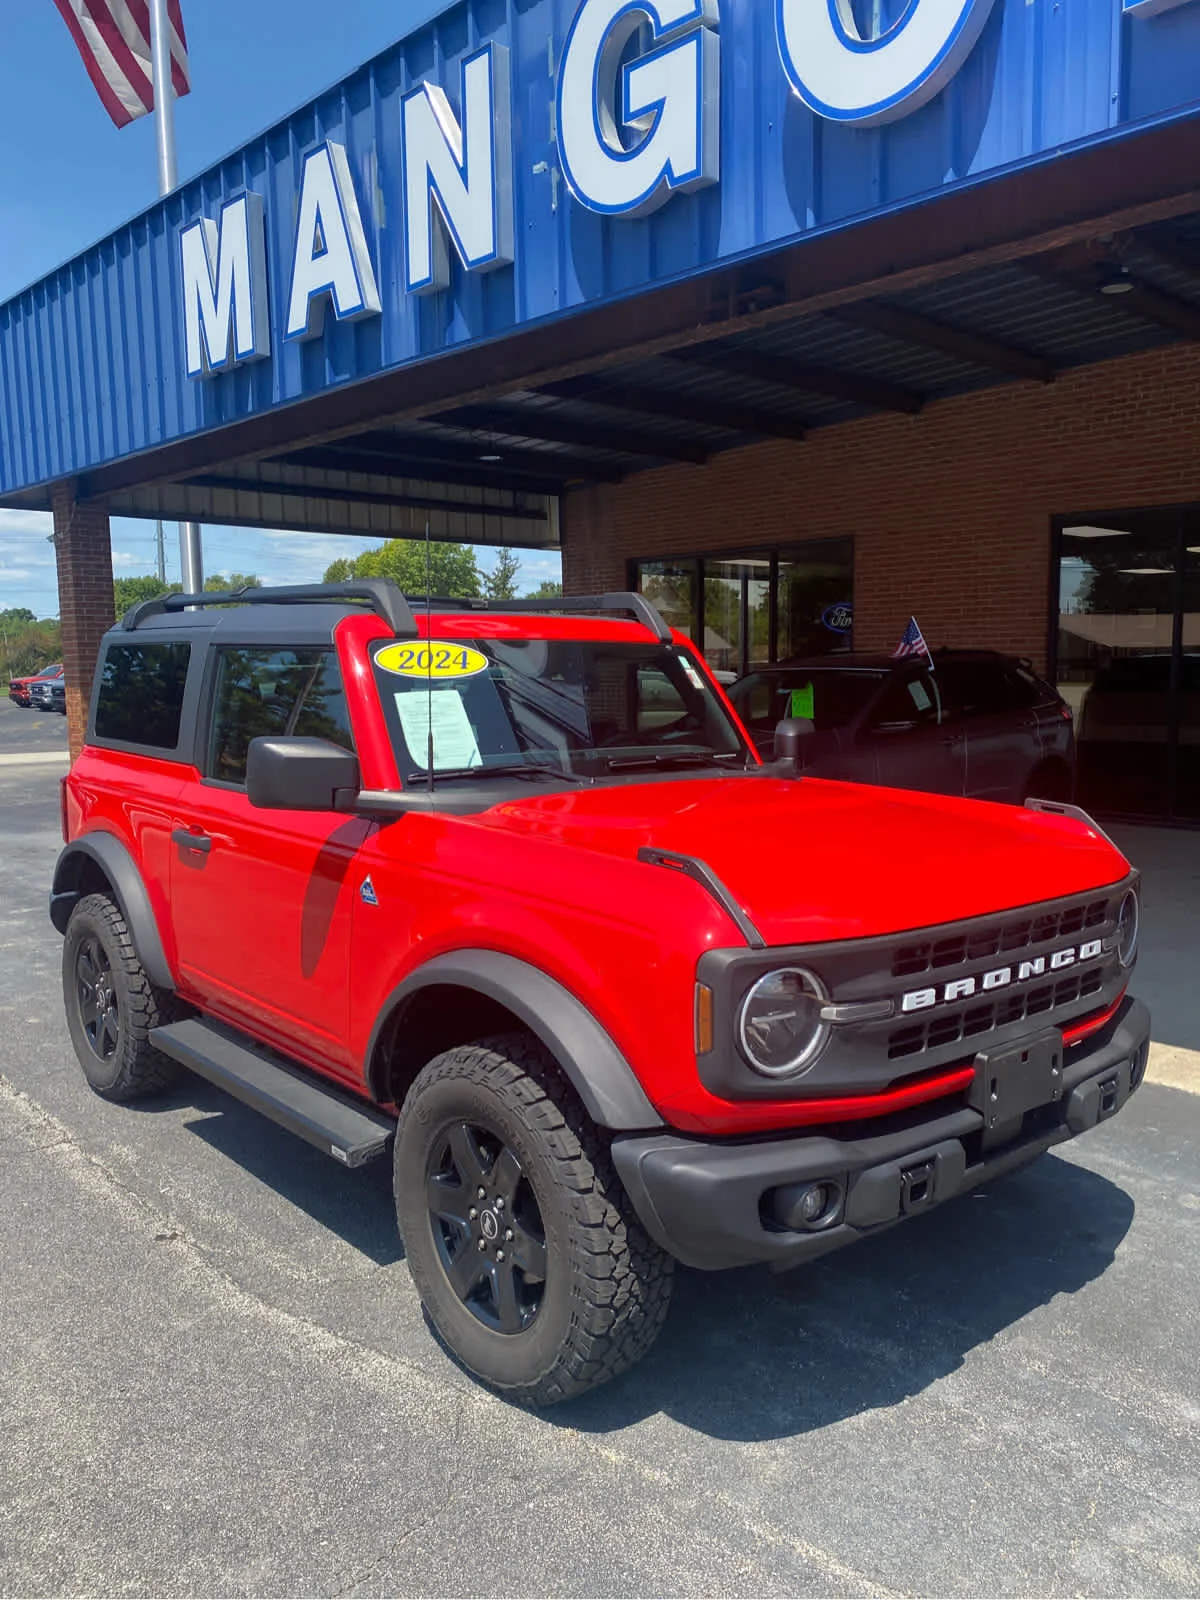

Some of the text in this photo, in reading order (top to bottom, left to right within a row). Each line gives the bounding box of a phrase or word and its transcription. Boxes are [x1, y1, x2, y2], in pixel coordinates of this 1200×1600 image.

[179, 0, 1200, 379] MANG
[398, 649, 470, 670] 2024
[902, 939, 1102, 1012] BRONCO
